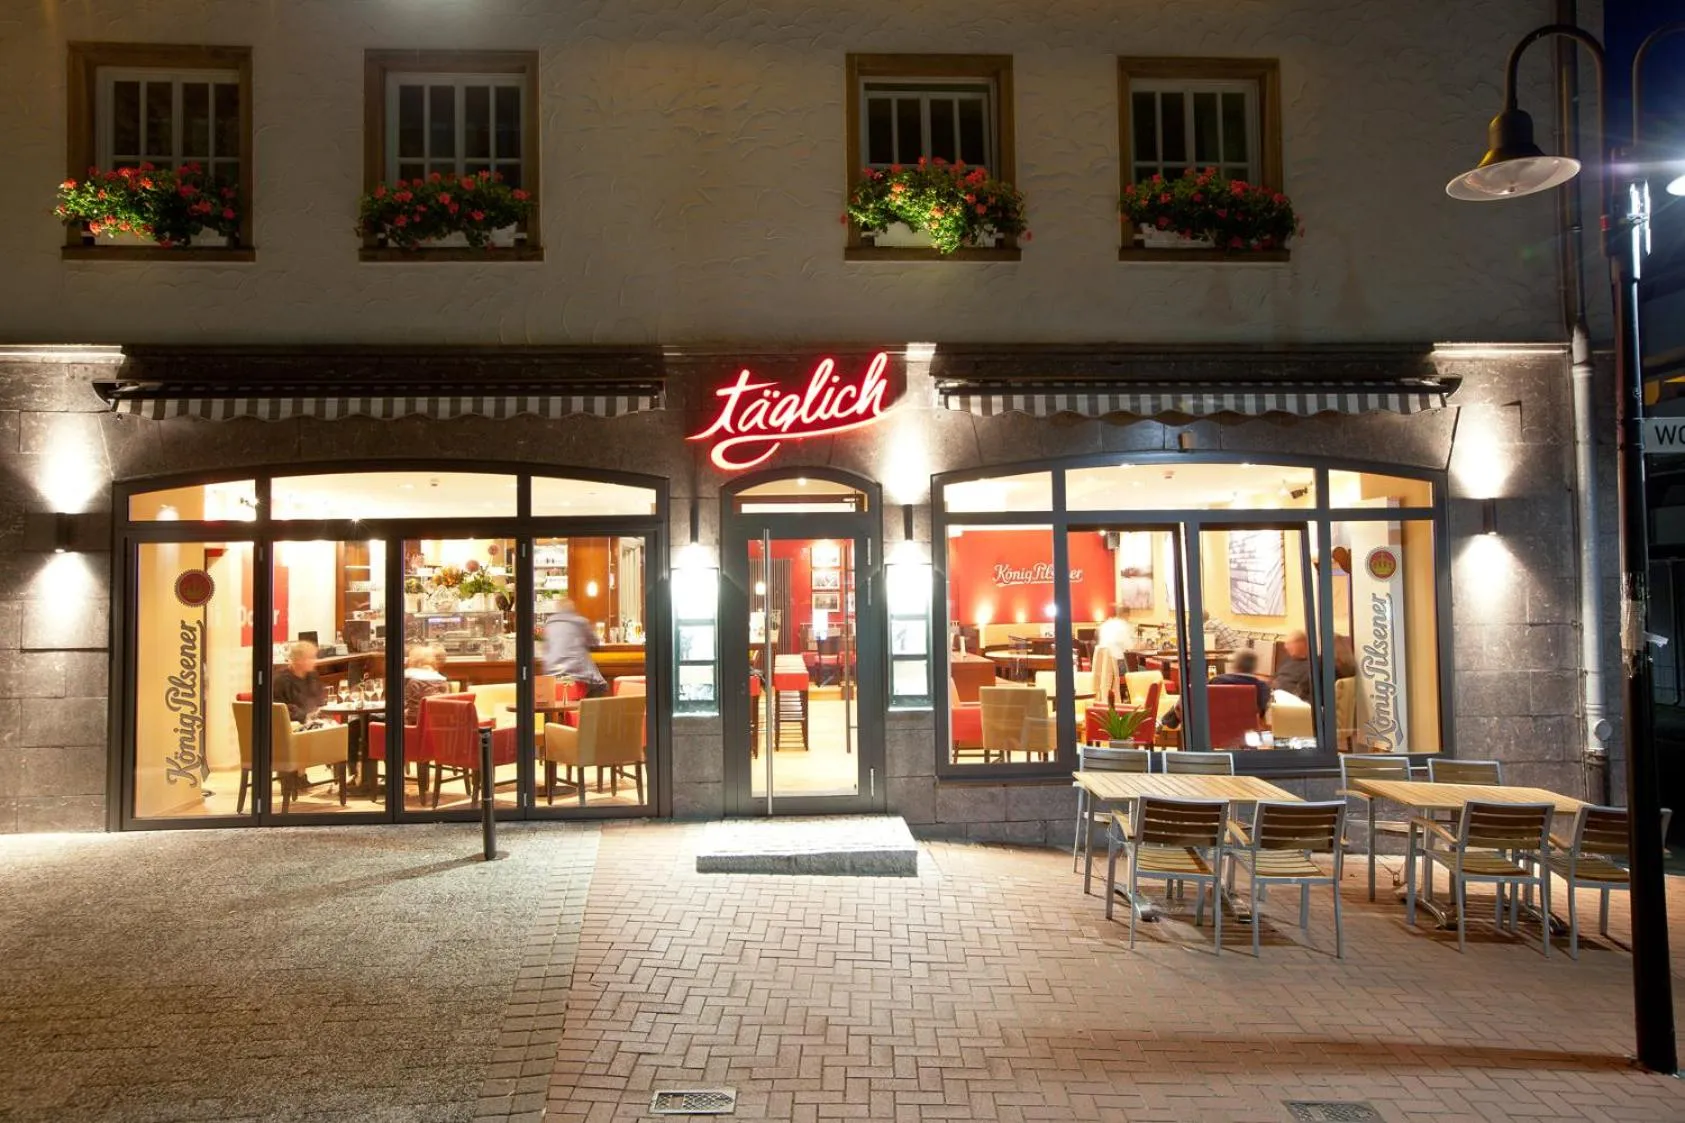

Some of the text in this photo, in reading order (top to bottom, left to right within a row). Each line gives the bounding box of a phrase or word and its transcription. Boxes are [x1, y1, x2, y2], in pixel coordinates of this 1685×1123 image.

[685, 352, 890, 470] täglich
[992, 564, 1033, 586] König
[165, 619, 205, 788] König Pilsener
[1361, 592, 1397, 751] König Pilsener
